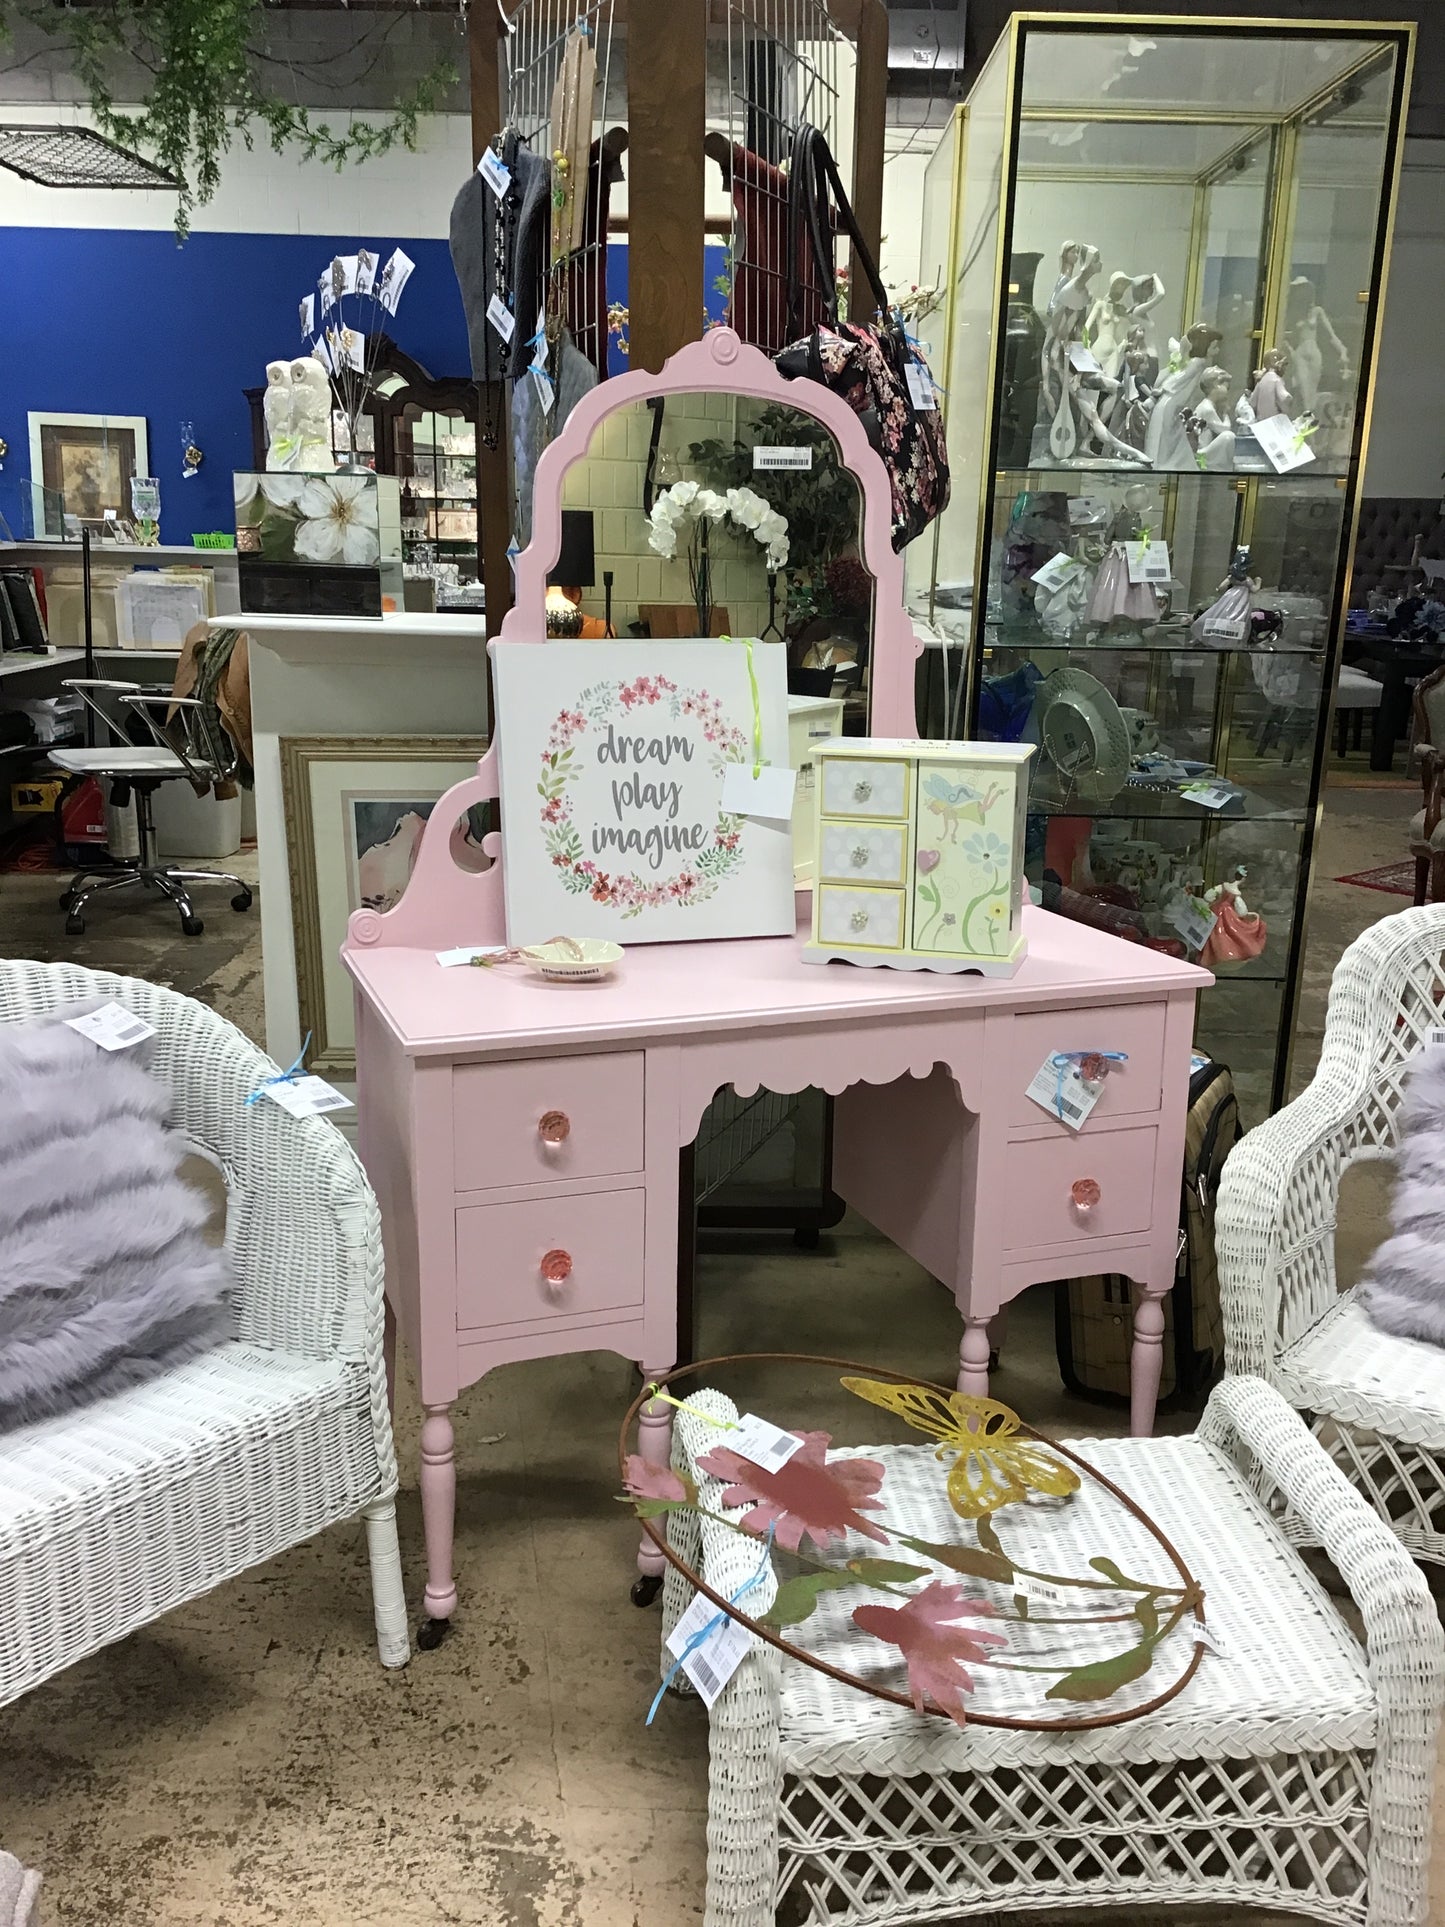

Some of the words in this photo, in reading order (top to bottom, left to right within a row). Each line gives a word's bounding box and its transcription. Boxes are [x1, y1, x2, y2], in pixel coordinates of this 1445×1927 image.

[597, 724, 694, 765] dream
[612, 772, 682, 821] play
[591, 820, 708, 869] imagine
